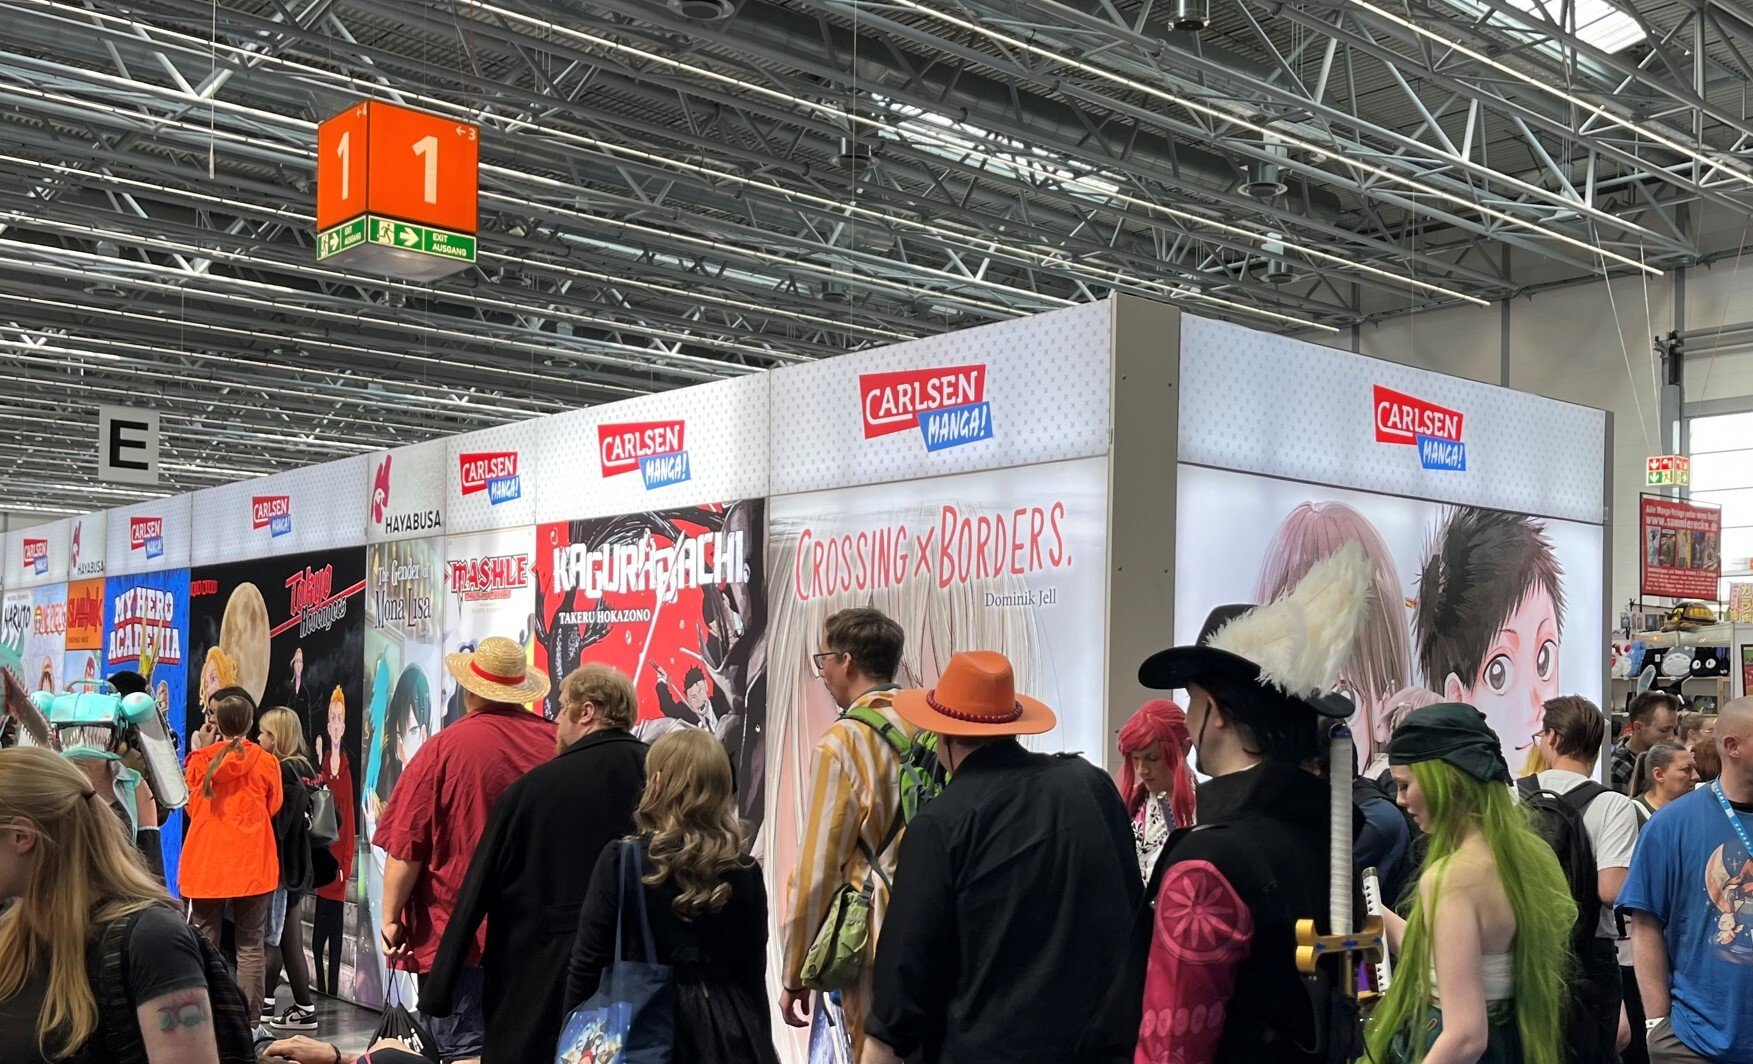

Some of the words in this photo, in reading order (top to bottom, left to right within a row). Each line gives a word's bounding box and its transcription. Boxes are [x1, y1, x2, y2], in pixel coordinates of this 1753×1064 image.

[468, 127, 476, 141] 3
[337, 131, 350, 200] 1
[412, 135, 438, 205] 1
[432, 232, 448, 243] EXIT
[432, 242, 467, 257] AUSGANG
[865, 370, 978, 425] CARLSEN
[927, 404, 987, 445] MANGA!
[1377, 401, 1458, 439] CARLSEN
[109, 419, 149, 471] E
[602, 424, 680, 467] CARLSEN
[1423, 439, 1463, 468] MANGA!
[462, 455, 515, 487] CARLSEN
[645, 453, 687, 485] MANGA!
[491, 477, 518, 501] MANGA!
[253, 498, 288, 523] CARLSEN
[385, 509, 442, 534] HAYABUSA
[131, 520, 161, 544] CARLSEN
[795, 528, 908, 601] CROSSING
[938, 500, 1073, 589] BORDERS.
[77, 559, 105, 575] HAYABUSA
[391, 557, 420, 587] Gender
[448, 553, 528, 596] MASHLE
[553, 530, 745, 604] KAGURABACHI
[115, 588, 135, 623] MY
[136, 587, 173, 622] HERO
[375, 590, 405, 628] Mona
[407, 588, 430, 627] Lisa
[985, 591, 1036, 607] Dominik
[1037, 588, 1056, 605] Jell
[559, 611, 594, 625] TAKERU
[596, 609, 650, 622] HOKAZONO
